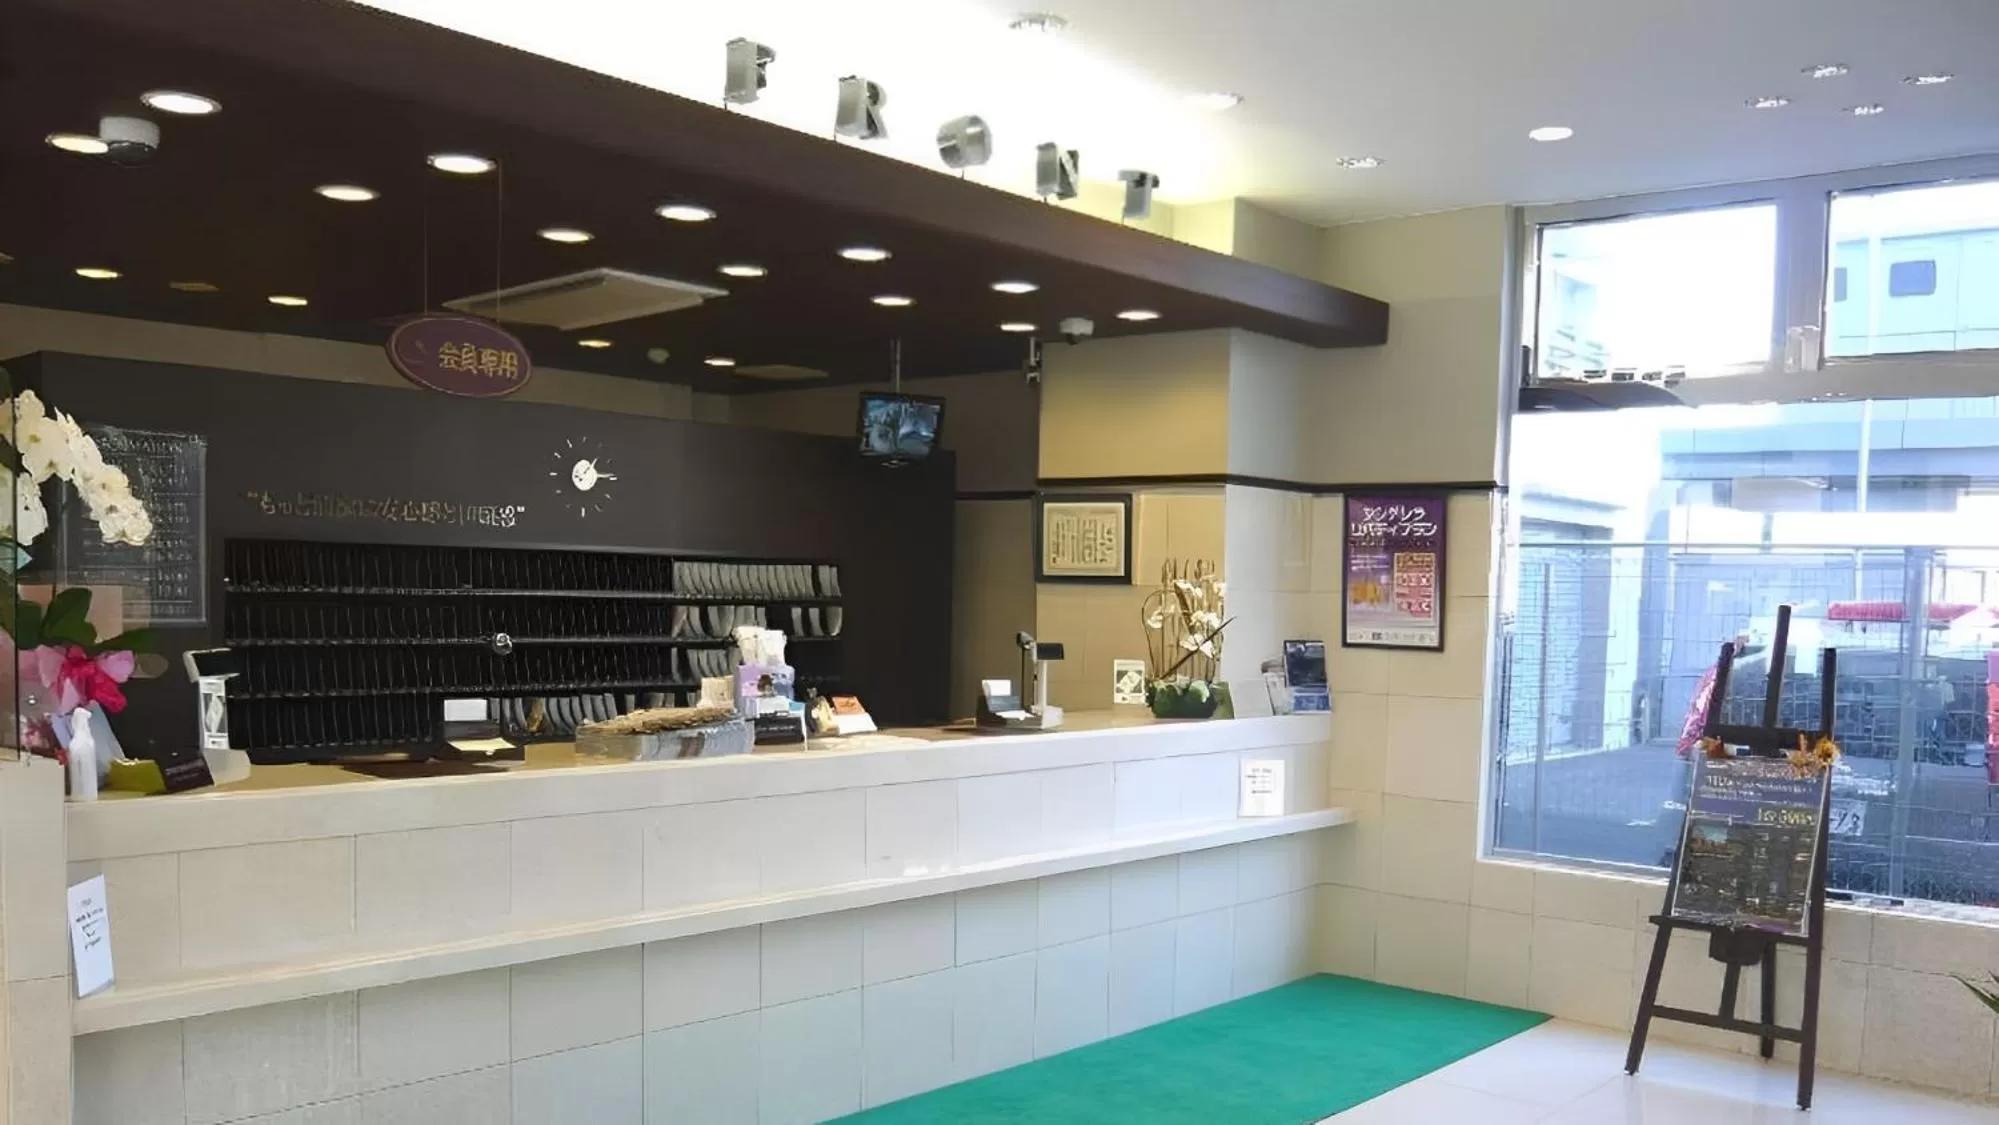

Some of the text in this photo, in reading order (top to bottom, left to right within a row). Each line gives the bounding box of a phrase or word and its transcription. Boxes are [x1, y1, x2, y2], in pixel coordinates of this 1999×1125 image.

[725, 36, 1160, 219] FRONT
[439, 342, 518, 379] 会員専用
